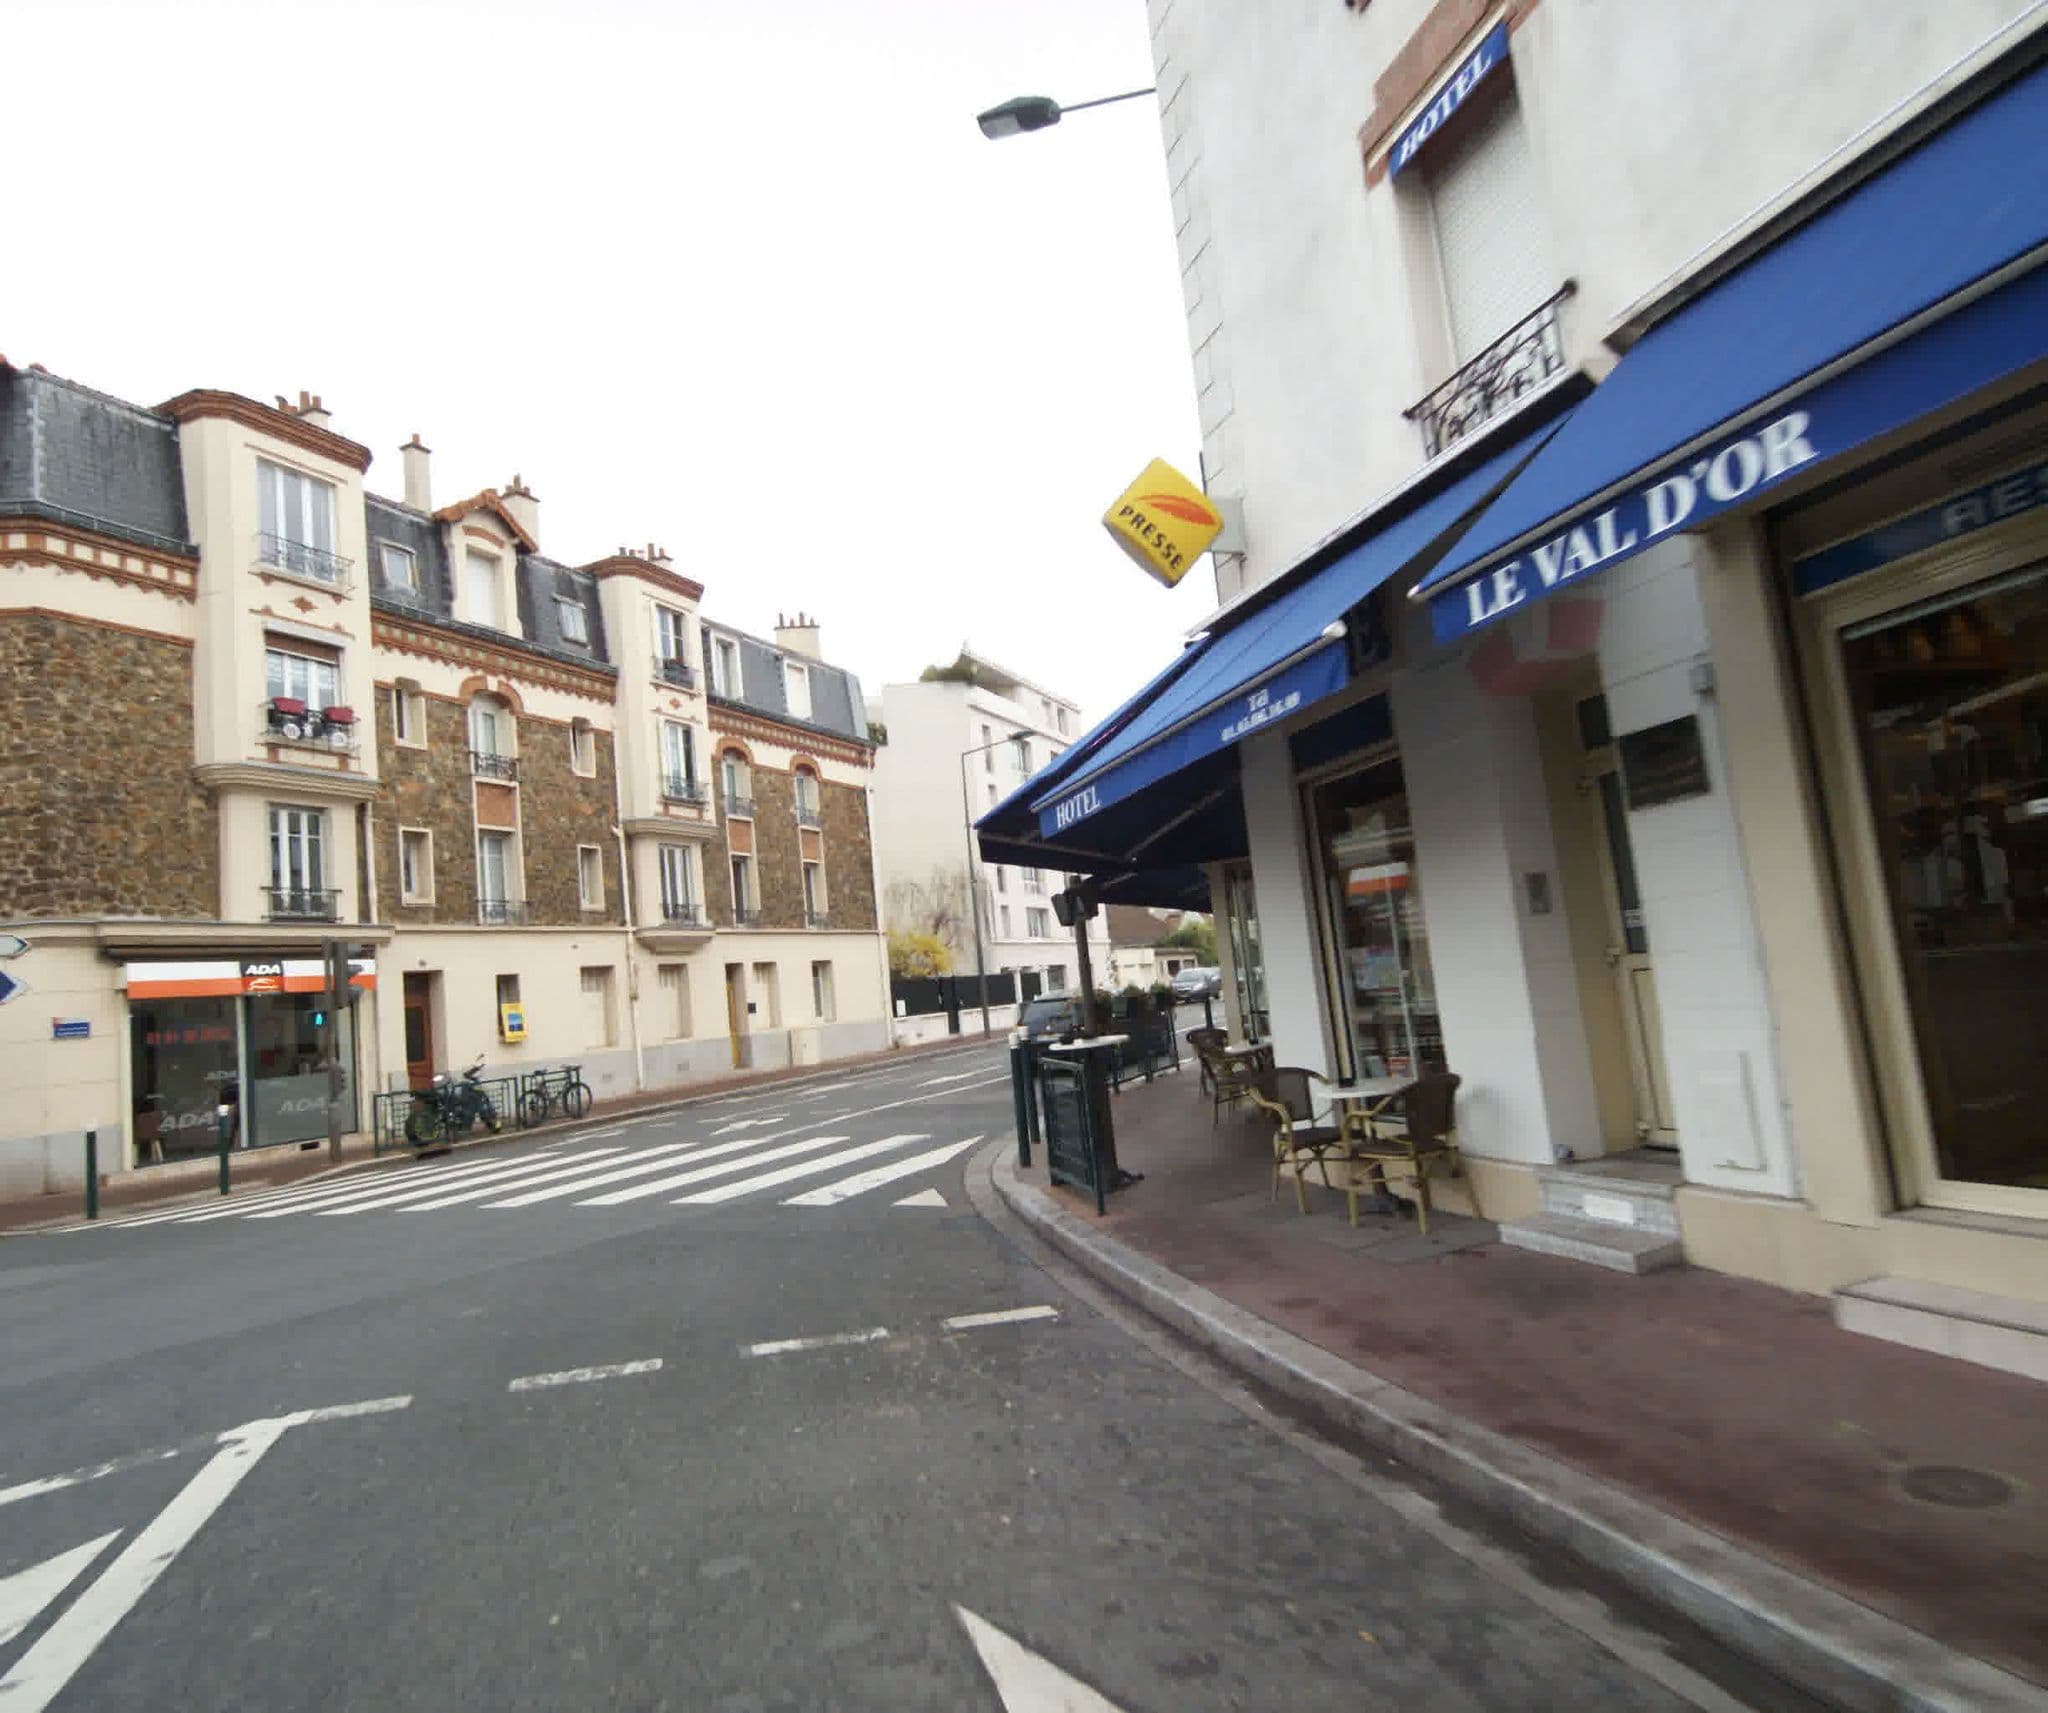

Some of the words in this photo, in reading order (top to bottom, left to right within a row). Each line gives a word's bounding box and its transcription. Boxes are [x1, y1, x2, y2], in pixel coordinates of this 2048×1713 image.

[1399, 50, 1492, 164] HOTEL
[1465, 560, 1526, 627] LE
[1531, 507, 1638, 588] VAL
[1643, 410, 1821, 539] D'OR
[1942, 466, 2048, 536] RE
[1118, 504, 1185, 570] PRESSE
[1056, 785, 1102, 829] HOTEL
[245, 963, 281, 976] ADA
[158, 1110, 215, 1132] ADA
